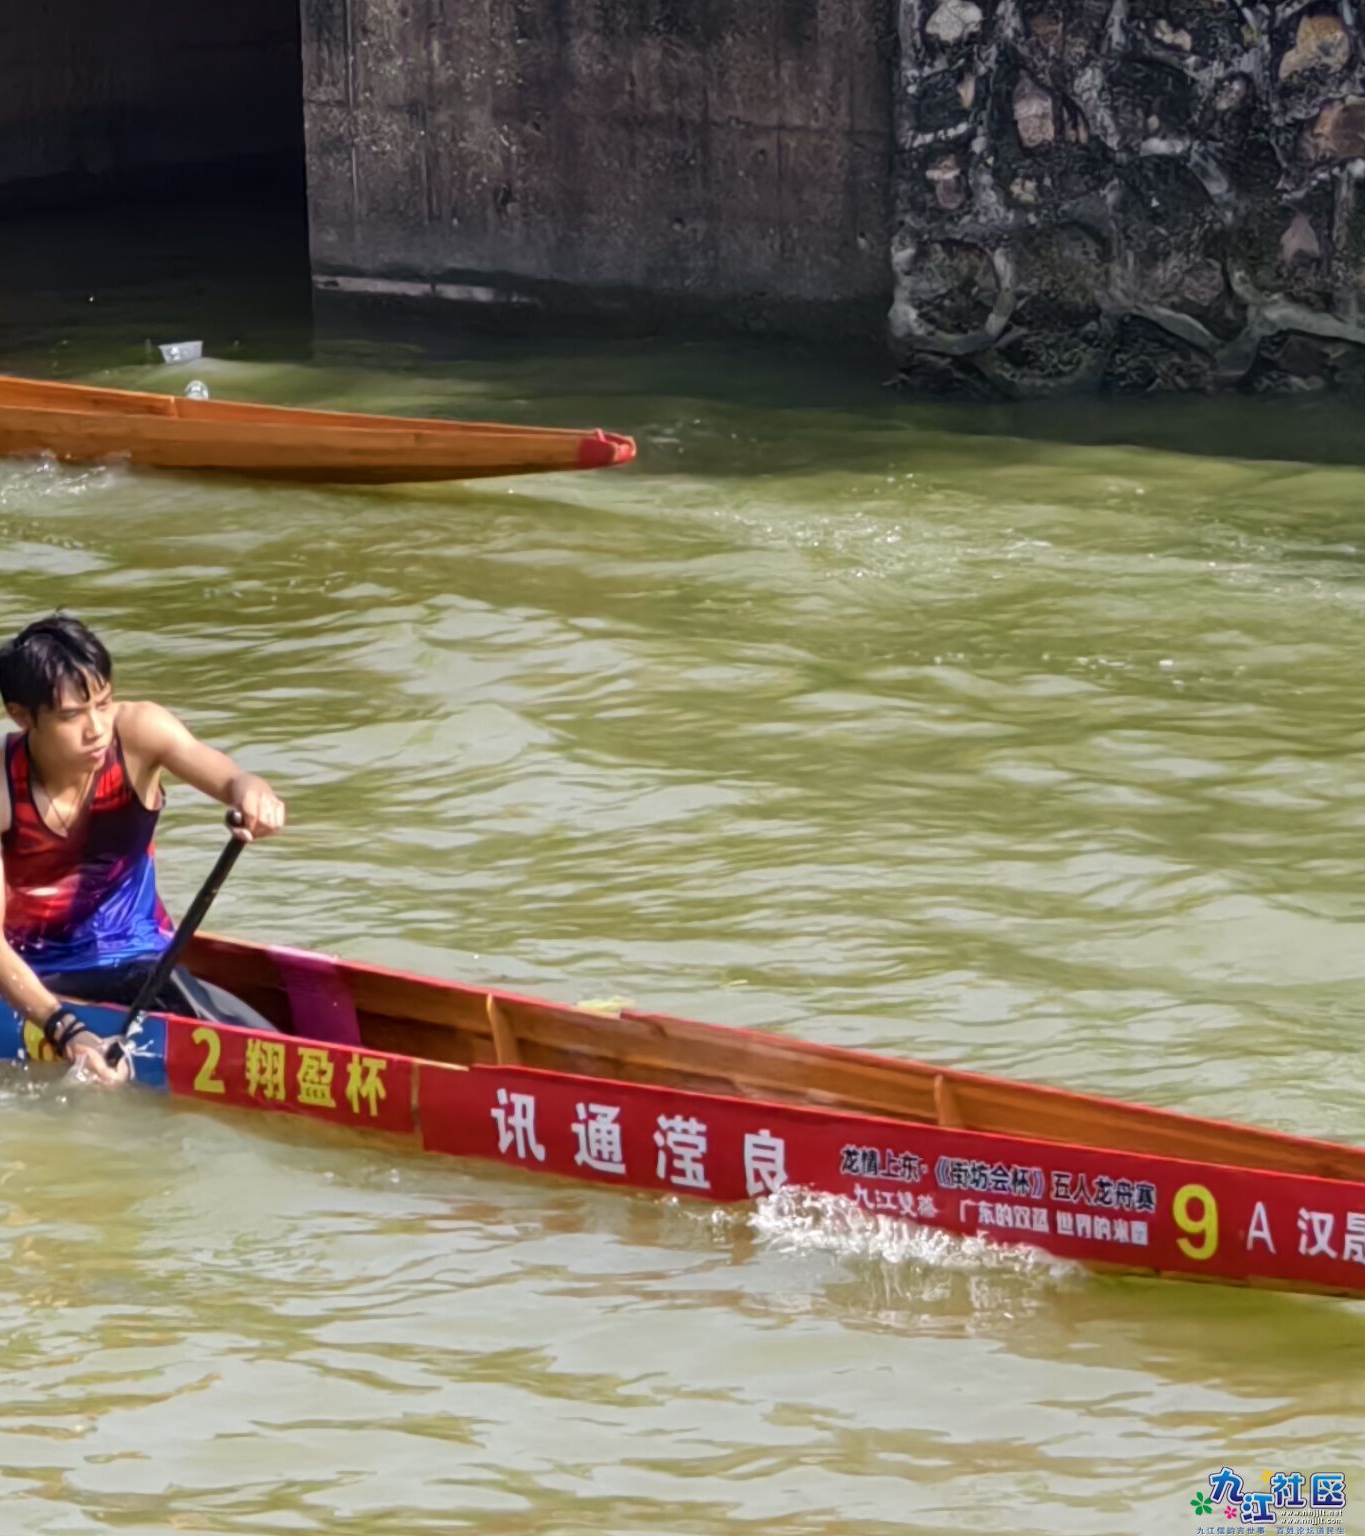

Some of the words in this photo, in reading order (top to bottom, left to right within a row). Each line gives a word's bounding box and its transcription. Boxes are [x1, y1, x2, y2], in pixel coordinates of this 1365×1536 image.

[244, 1038, 388, 1118] 翔盈杯
[1172, 1183, 1219, 1261] 9
[1246, 1201, 1276, 1255] A
